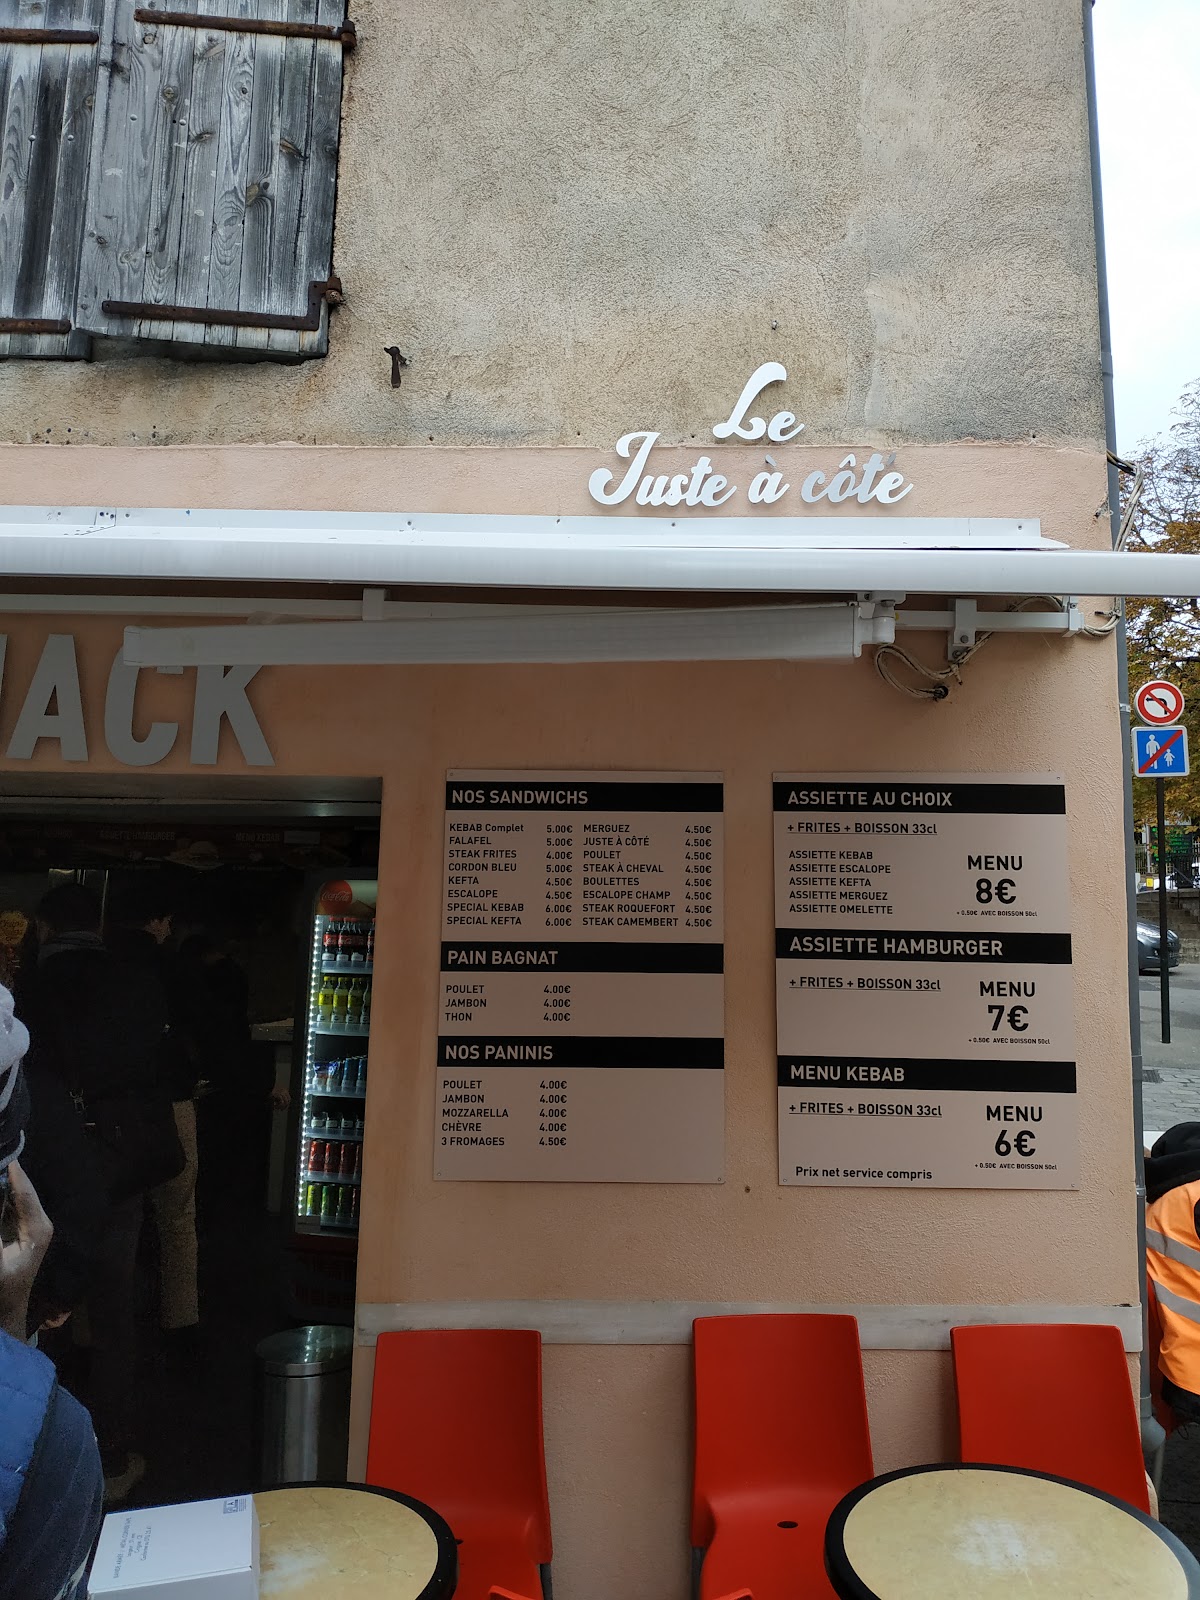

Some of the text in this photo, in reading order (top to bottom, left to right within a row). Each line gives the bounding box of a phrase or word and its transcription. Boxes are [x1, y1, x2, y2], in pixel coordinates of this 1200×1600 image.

[712, 361, 805, 442] Le
[588, 431, 914, 507] Juste à côté
[0, 633, 275, 767] ACK
[453, 790, 588, 804] NOS SANDWICHS
[788, 791, 952, 806] ASSIETTE AU CHOIX
[486, 824, 523, 833] Complet
[547, 825, 572, 833] 5.00€
[797, 822, 841, 833] FRITES
[854, 823, 909, 833] BOISSON
[912, 823, 938, 834] 33cl
[547, 838, 572, 846] 5.00€
[616, 835, 622, 845] À
[625, 836, 649, 846] CÔTÉ
[685, 839, 711, 847] 4.50€
[483, 850, 516, 858] FRITES
[546, 851, 572, 859] 4.00€
[685, 852, 711, 860] 4.50€
[789, 851, 872, 859] ASSIETTE KEBAB
[449, 863, 488, 871] CORDON
[492, 863, 516, 871] BLEU
[583, 862, 711, 873] STEAK À CHEVAL 4.50€
[968, 855, 1022, 870] MENU
[789, 864, 890, 873] ASSIETTE ESCALOPE
[449, 876, 572, 886] KEFTA 4.50€
[584, 877, 639, 885] BOULETTES
[789, 877, 871, 886] ASSIETTE KEFTA
[546, 891, 572, 899] 4.50€
[583, 891, 711, 900] ESCALOPE CHAMP 4.50€
[790, 891, 887, 900] ASSIETTE MERGUEZ
[976, 878, 1016, 904] 8€
[447, 903, 572, 913] SPECIAL KEBAB 6.00€
[583, 904, 712, 913] STEAK ROQUEFORT 4.50€
[790, 904, 892, 914] ASSIETTE OMELETTE
[491, 917, 521, 925] KEFTA
[546, 918, 571, 926] 6.00€
[583, 917, 712, 927] STEAK CAMEMBERT 4.50€
[790, 937, 1002, 955] ASSIETTE HAMBURGER
[448, 951, 558, 964] PAIN BAGNAT
[800, 977, 844, 988] FRITES
[857, 977, 912, 989] BOISSON
[915, 979, 941, 990] 33cl
[446, 985, 570, 993] POULET 4.00€
[980, 981, 1035, 997] MENU
[446, 999, 570, 1007] JAMBON 4.00€
[445, 1013, 570, 1021] THON 4.00€
[988, 1005, 1028, 1031] 7€
[446, 1045, 553, 1059] NOS PANINIS
[791, 1065, 904, 1081] MENU KEBAB
[443, 1080, 567, 1089] POULET 4.00€
[443, 1095, 567, 1103] JAMBON 4.00€
[443, 1109, 566, 1117] MOZZARELLA 4.00€
[800, 1102, 844, 1113] FRITES
[857, 1103, 913, 1115] BOISSON
[916, 1104, 942, 1116] 33cl
[987, 1105, 1042, 1122] MENU
[442, 1120, 566, 1131] CHÈVRE 4.00€
[442, 1137, 566, 1145] 3 FROMAGES 4.50€
[995, 1130, 1035, 1156] 6€
[796, 1166, 932, 1181] Prix net service compris
